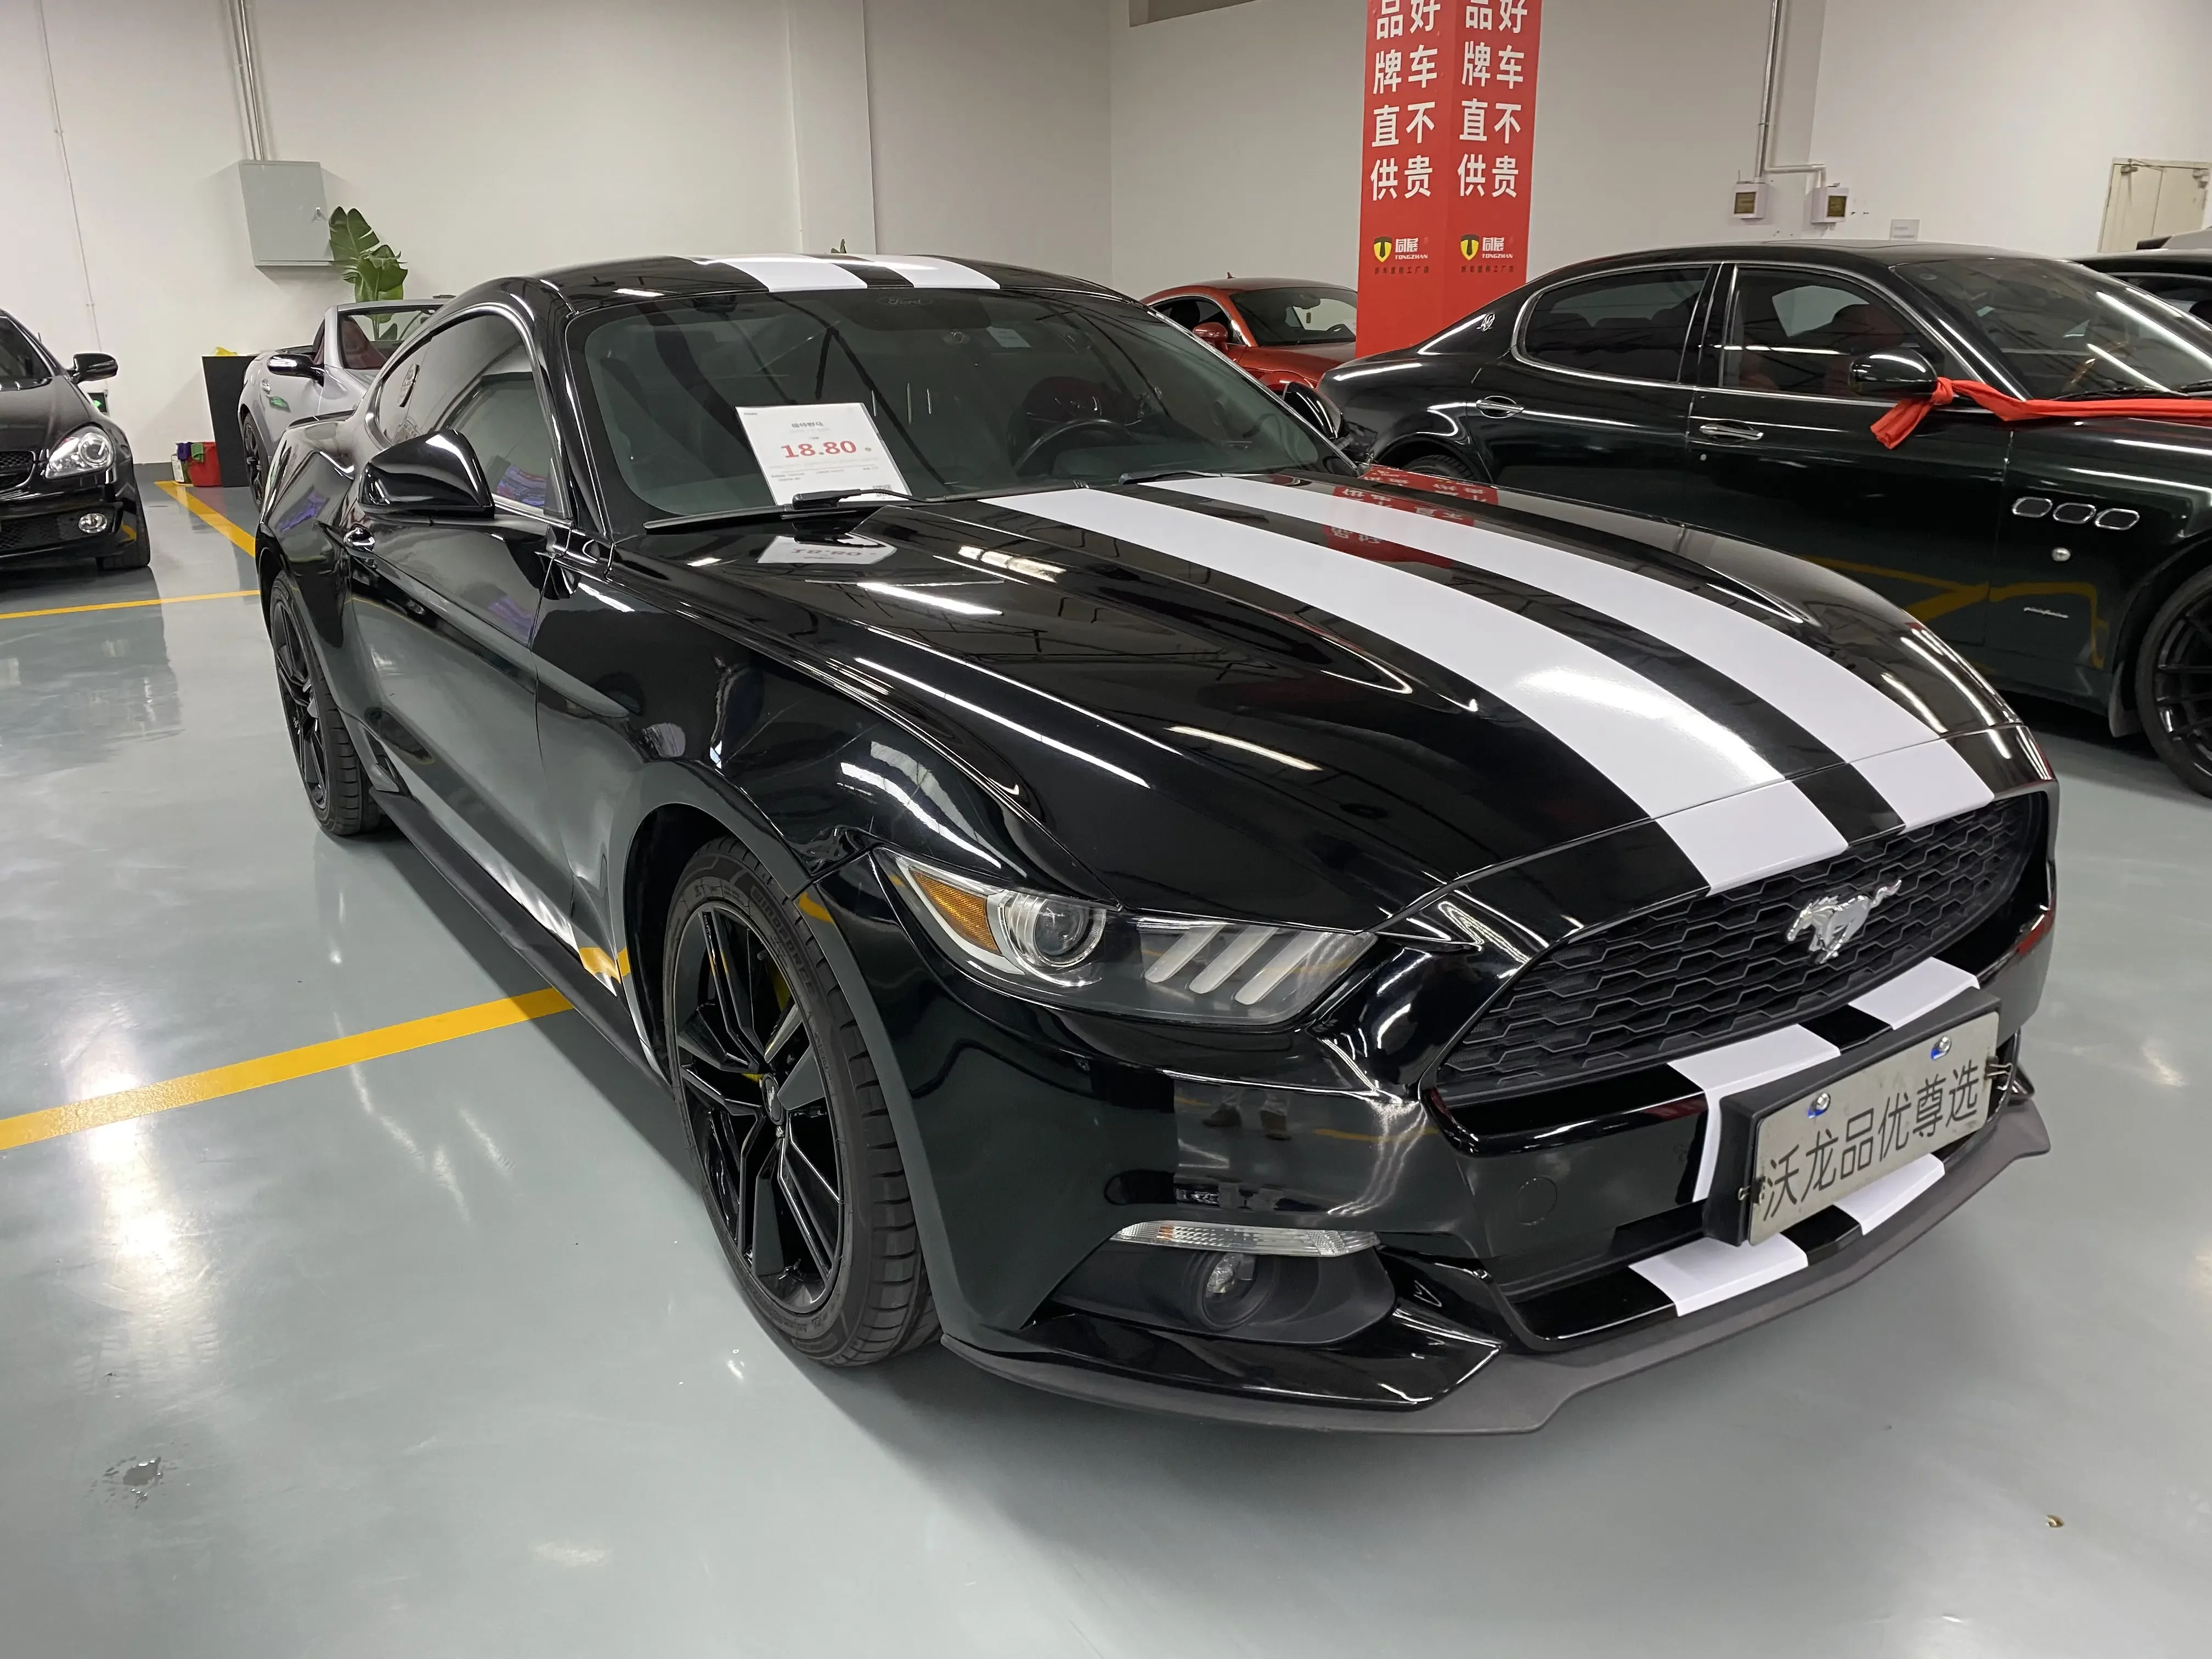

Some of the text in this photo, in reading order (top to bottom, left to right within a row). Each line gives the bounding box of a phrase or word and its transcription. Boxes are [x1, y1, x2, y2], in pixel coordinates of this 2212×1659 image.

[1370, 0, 1404, 201] 品牌直供
[1404, 0, 1441, 199] 好车不贵
[1457, 0, 1493, 197] 品牌直供
[1491, 0, 1528, 198] 好车不贵
[781, 441, 857, 458] 18.80
[1763, 1059, 1980, 1221] 沃龙品优尊选
